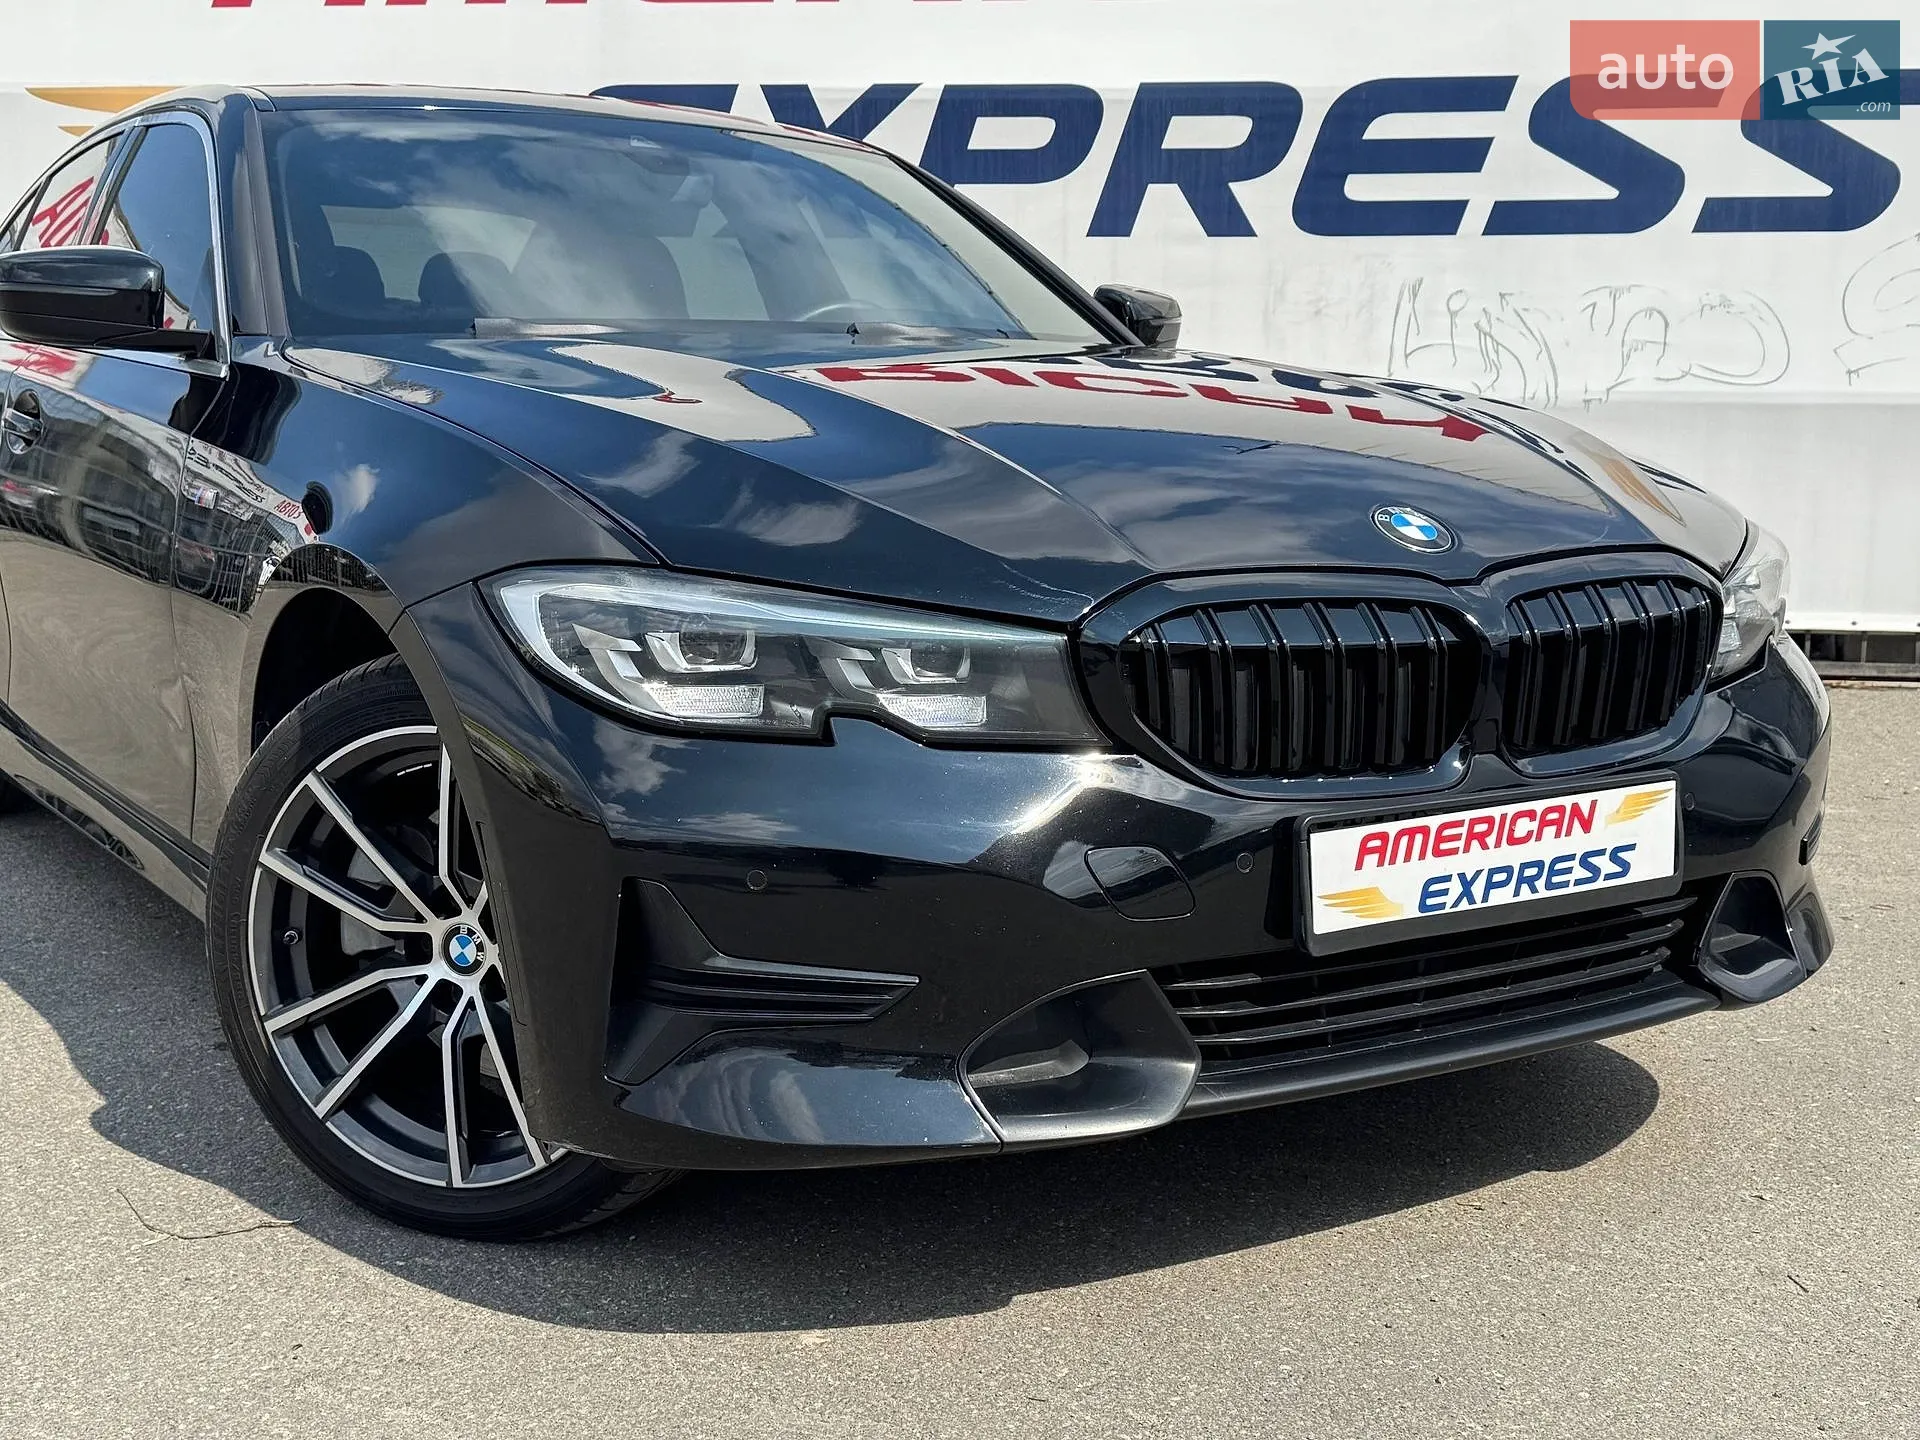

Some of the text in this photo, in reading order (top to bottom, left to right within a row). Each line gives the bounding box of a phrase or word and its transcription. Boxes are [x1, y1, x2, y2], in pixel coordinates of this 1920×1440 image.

[1354, 799, 1599, 871] AMERICAN
[1418, 843, 1637, 914] EXPRESS
[459, 925, 485, 962] BMW
